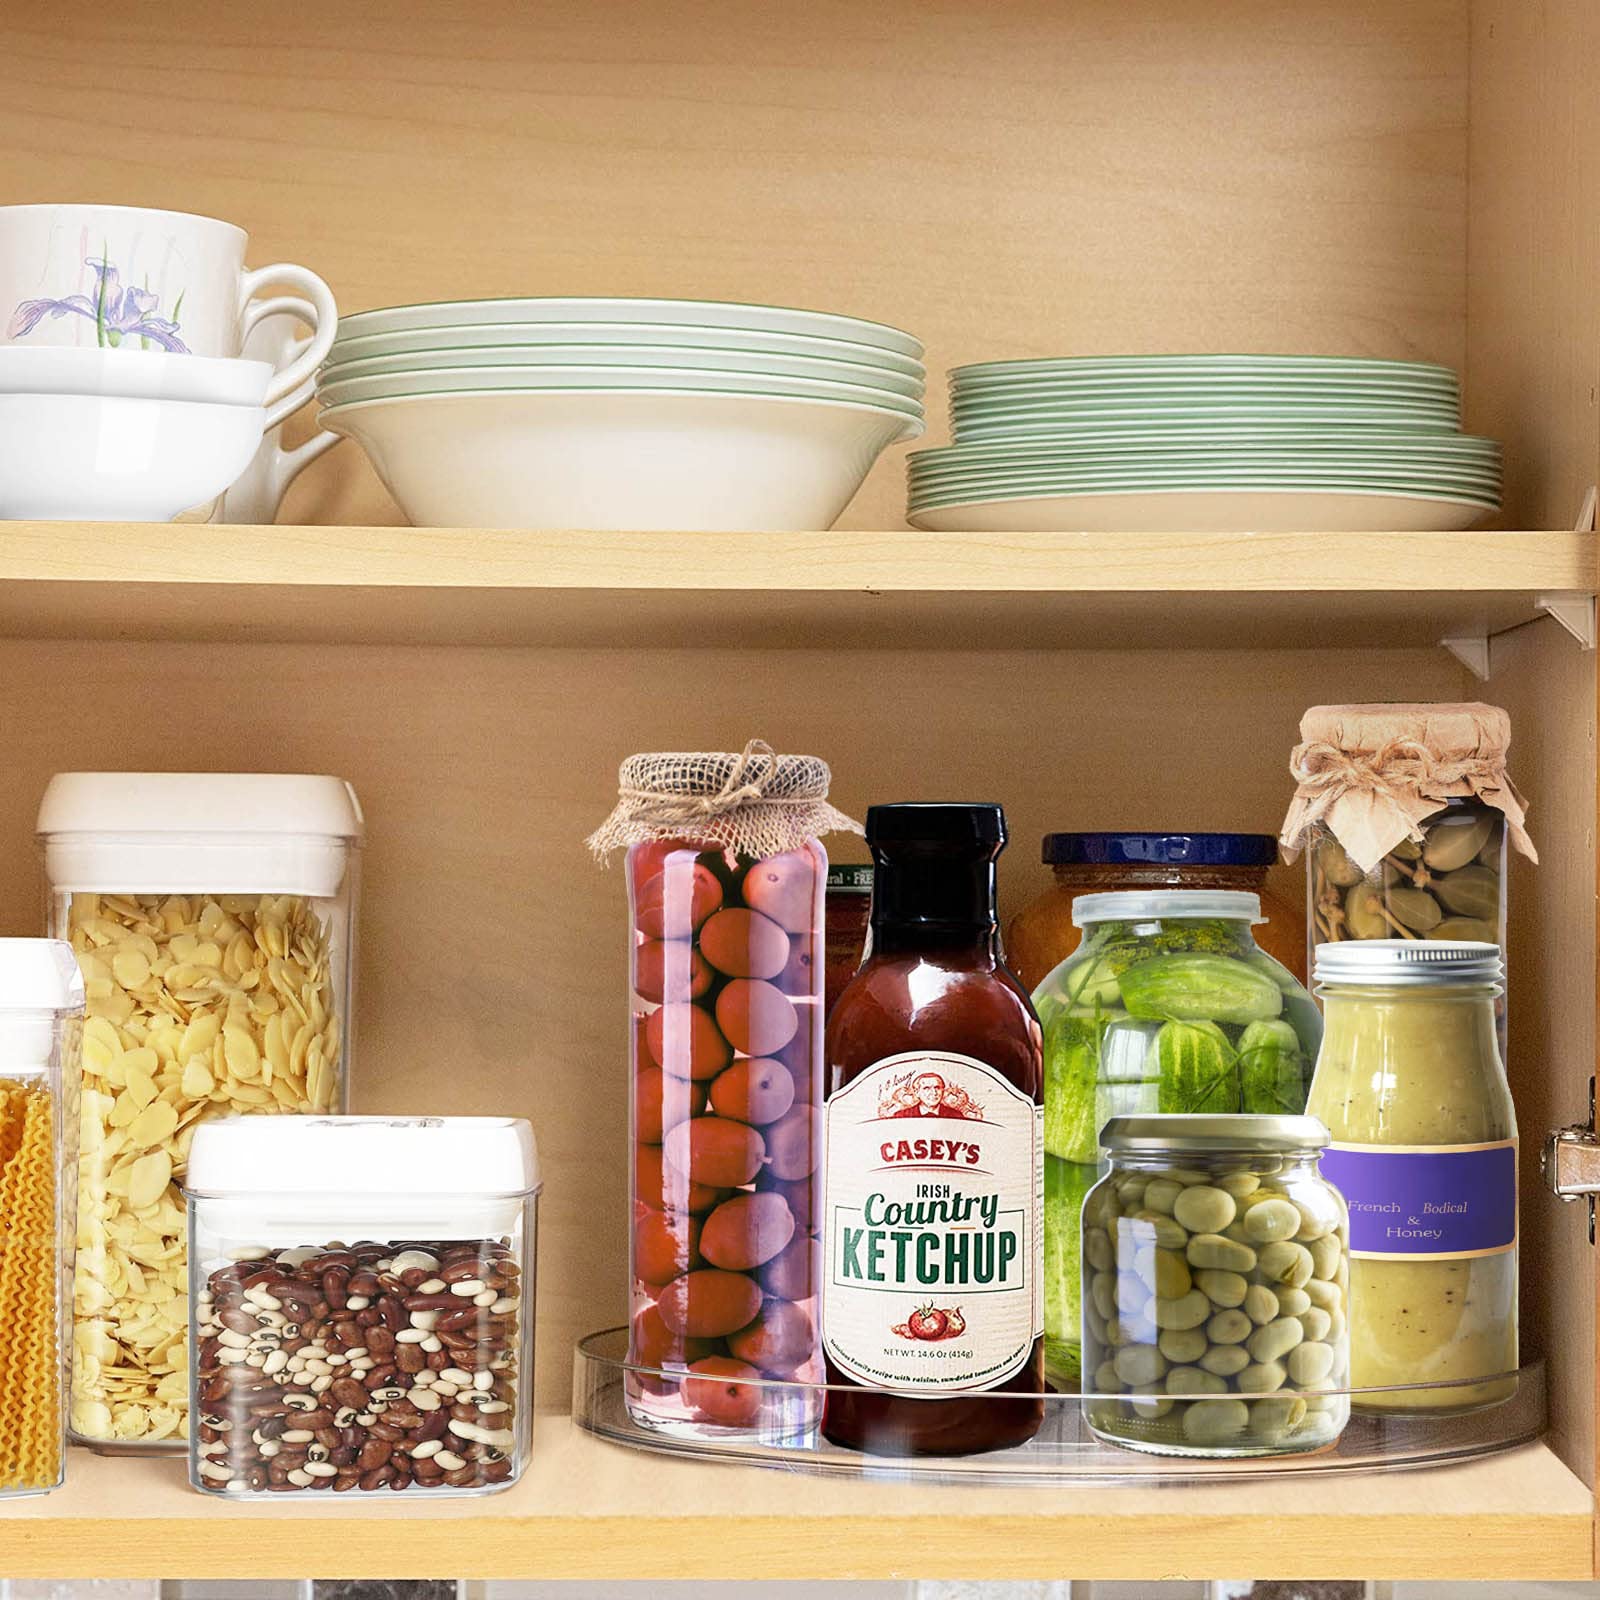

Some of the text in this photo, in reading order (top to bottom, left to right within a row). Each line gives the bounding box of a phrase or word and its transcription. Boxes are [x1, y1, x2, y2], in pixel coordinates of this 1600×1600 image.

[880, 1139, 980, 1165] CASEY'S
[916, 1184, 950, 1198] IRISH
[864, 1192, 999, 1228] Country
[1348, 1200, 1468, 1214] French Bodical
[1407, 1216, 1420, 1225] &
[1386, 1227, 1442, 1239] Honey
[842, 1227, 1017, 1285] KETCHUP
[883, 1348, 899, 1356] NET
[948, 1350, 973, 1359] (414g)
